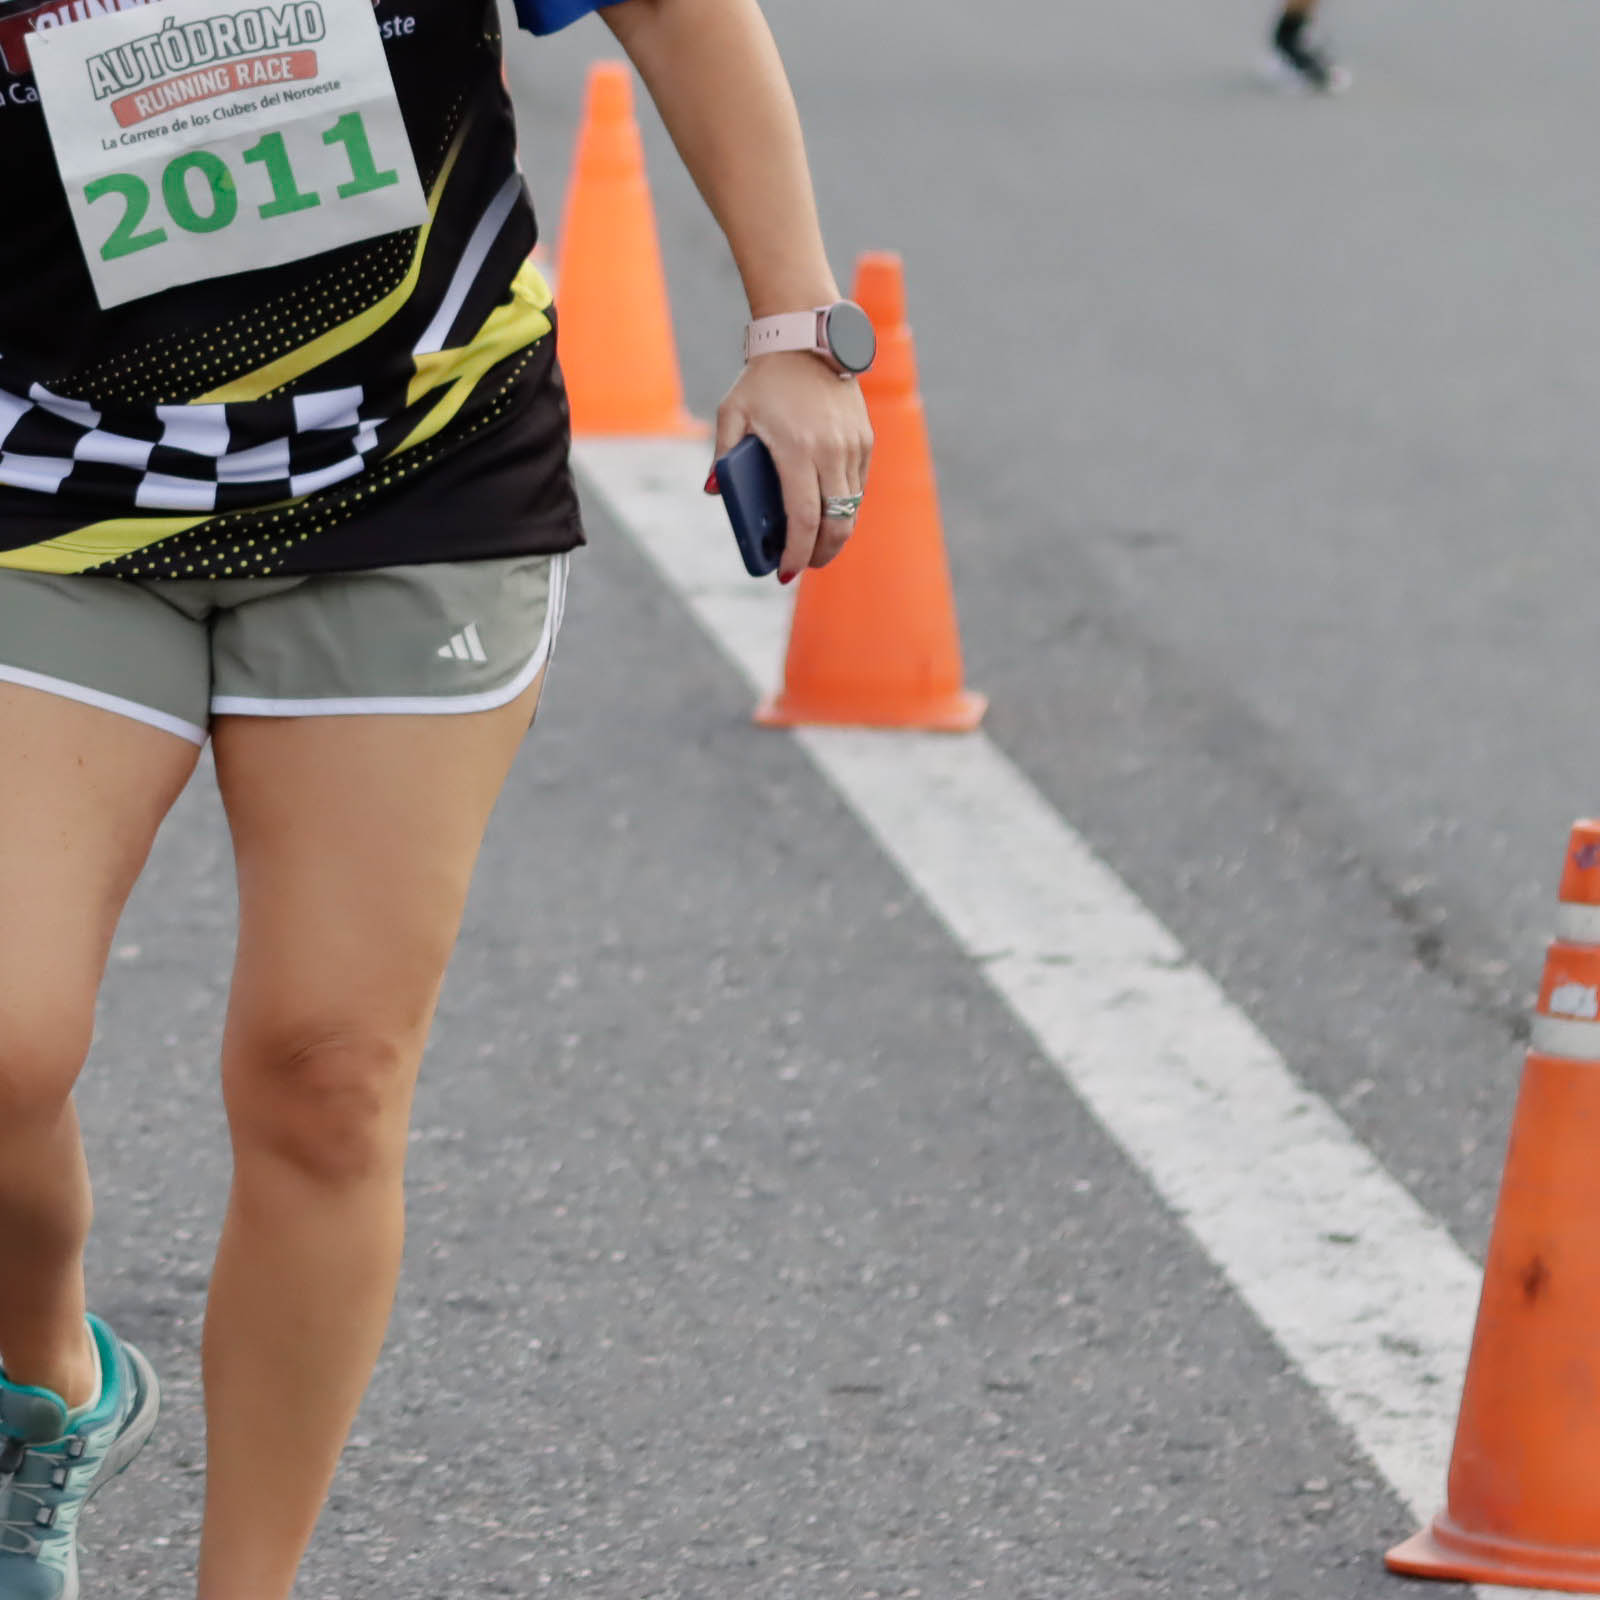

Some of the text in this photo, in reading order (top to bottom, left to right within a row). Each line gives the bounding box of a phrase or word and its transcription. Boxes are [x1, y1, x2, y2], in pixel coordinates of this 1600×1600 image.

[86, 1, 325, 100] AUTÓDROMO
[135, 56, 293, 118] RUNNING RACE
[102, 79, 341, 151] La Carrera de los Clubes del Noroeste
[83, 111, 399, 262] 2011
